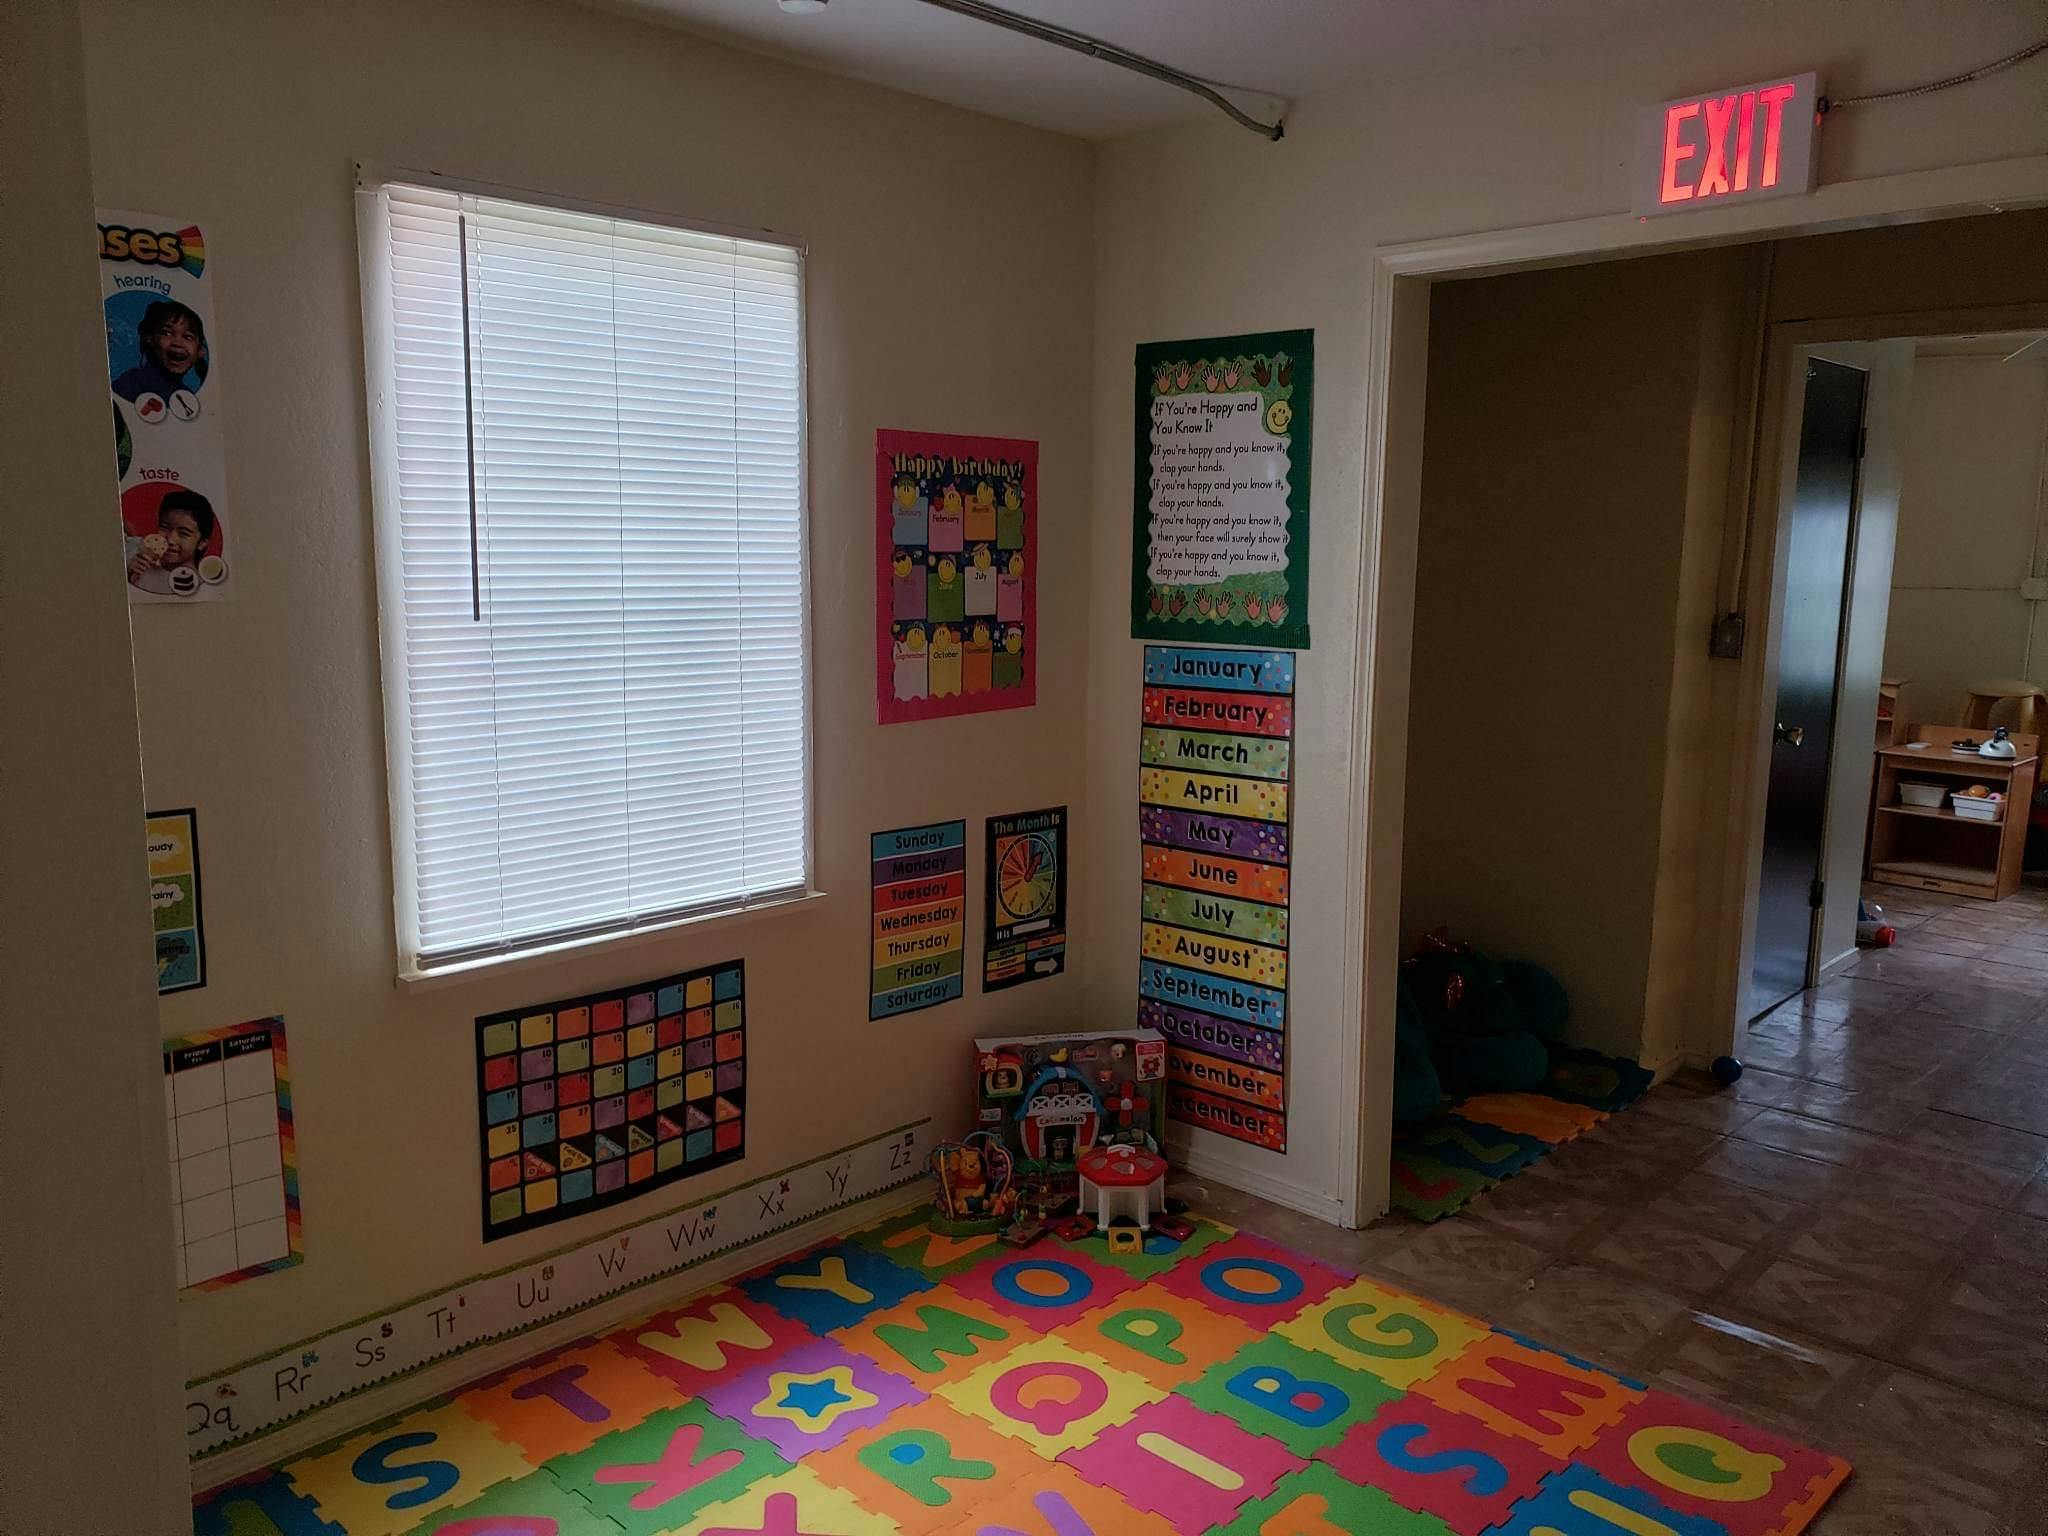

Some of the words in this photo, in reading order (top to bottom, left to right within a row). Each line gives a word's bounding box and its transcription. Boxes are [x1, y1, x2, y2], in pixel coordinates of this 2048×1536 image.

[1660, 82, 1796, 204] EXIT
[97, 223, 184, 268] ses
[113, 275, 171, 295] hearing
[1154, 402, 1164, 416] If
[1166, 401, 1197, 416] You're
[1200, 399, 1234, 418] Happy
[1237, 397, 1258, 412] and
[1154, 422, 1172, 434] You
[1175, 420, 1202, 434] Know
[1205, 418, 1213, 433] It
[1153, 444, 1160, 456] If
[1162, 444, 1186, 459] you're
[1188, 442, 1212, 458] happy
[1215, 442, 1232, 454] and
[1234, 445, 1248, 458] you
[1252, 440, 1274, 452] know
[139, 466, 180, 481] taste
[1160, 462, 1176, 477] clap
[1178, 464, 1196, 476] your
[1198, 460, 1225, 472] hands.
[1152, 478, 1160, 490] If
[1161, 479, 1186, 494] you're
[1188, 479, 1212, 494] happy
[1214, 478, 1230, 490] and
[1232, 481, 1248, 494] you
[1250, 478, 1272, 490] know
[1158, 497, 1175, 511] clap
[1177, 500, 1194, 511] your
[1197, 496, 1224, 508] hands.
[1151, 513, 1159, 525] If
[1160, 514, 1184, 528] you're
[1186, 513, 1210, 529] happy
[1213, 514, 1230, 525] and
[1232, 517, 1246, 528] you
[1249, 513, 1271, 525] know
[1158, 532, 1174, 543] then
[1176, 534, 1194, 546] your
[1196, 530, 1214, 542] face
[1216, 530, 1230, 542] will
[1232, 531, 1256, 546] surely
[1258, 532, 1280, 544] show
[1150, 547, 1158, 558] If
[1159, 548, 1182, 562] you're
[1184, 547, 1209, 564] happy
[1211, 548, 1228, 560] and
[1230, 552, 1244, 564] you
[1246, 548, 1268, 561] know
[1156, 565, 1172, 579] clap
[1174, 566, 1192, 579] your
[1194, 565, 1220, 578] hands.
[1172, 655, 1262, 684] January
[1164, 696, 1268, 727] February
[1178, 738, 1248, 764] March
[1184, 780, 1238, 804] April
[993, 820, 1014, 835] The
[1016, 814, 1050, 832] Month
[1188, 820, 1234, 848] May
[148, 843, 173, 852] oudy
[896, 833, 944, 850] Sunday
[892, 856, 947, 877] Monday
[1189, 859, 1238, 884] June
[891, 882, 948, 902] Tuesday
[880, 905, 958, 931] Wednesday
[1192, 899, 1234, 928] July
[888, 933, 950, 957] Thursday
[1175, 936, 1250, 968] August
[896, 960, 940, 981] Friday
[887, 983, 948, 1009] Saturday
[1153, 970, 1271, 1015] September
[542, 1049, 552, 1058] 10
[581, 1041, 588, 1050] 11
[614, 1034, 622, 1043] 12
[646, 1025, 653, 1034] 13
[1162, 1012, 1256, 1054] October
[506, 1090, 516, 1100] 17
[612, 1066, 622, 1076] 20
[646, 1057, 653, 1066] 21
[1169, 1055, 1267, 1096] ovember
[506, 1125, 516, 1134] 25
[543, 1115, 553, 1125] 26
[579, 1106, 588, 1116] 27
[672, 1079, 680, 1088] 30
[704, 1071, 712, 1079] 31
[1171, 1091, 1269, 1136] ecember
[275, 1366, 312, 1401] Rr
[355, 1337, 386, 1368] Ss
[427, 1307, 456, 1338] Tt
[517, 1278, 549, 1308] Uu
[598, 1248, 626, 1277] Vv
[667, 1218, 716, 1252] Ww
[758, 1191, 784, 1220] Xx
[826, 1166, 848, 1196] Yy
[889, 1143, 911, 1171] Zz
[775, 1255, 876, 1304] Y
[991, 1259, 1093, 1308] O
[1199, 1256, 1304, 1304] O
[1097, 1308, 1188, 1366] P
[1322, 1302, 1440, 1360] G
[511, 1363, 612, 1424] T
[989, 1361, 1109, 1436] Q
[1225, 1366, 1350, 1428] B
[351, 1431, 461, 1510] S
[856, 1428, 998, 1507] R
[1376, 1422, 1509, 1497] S
[1626, 1425, 1787, 1503] Q
